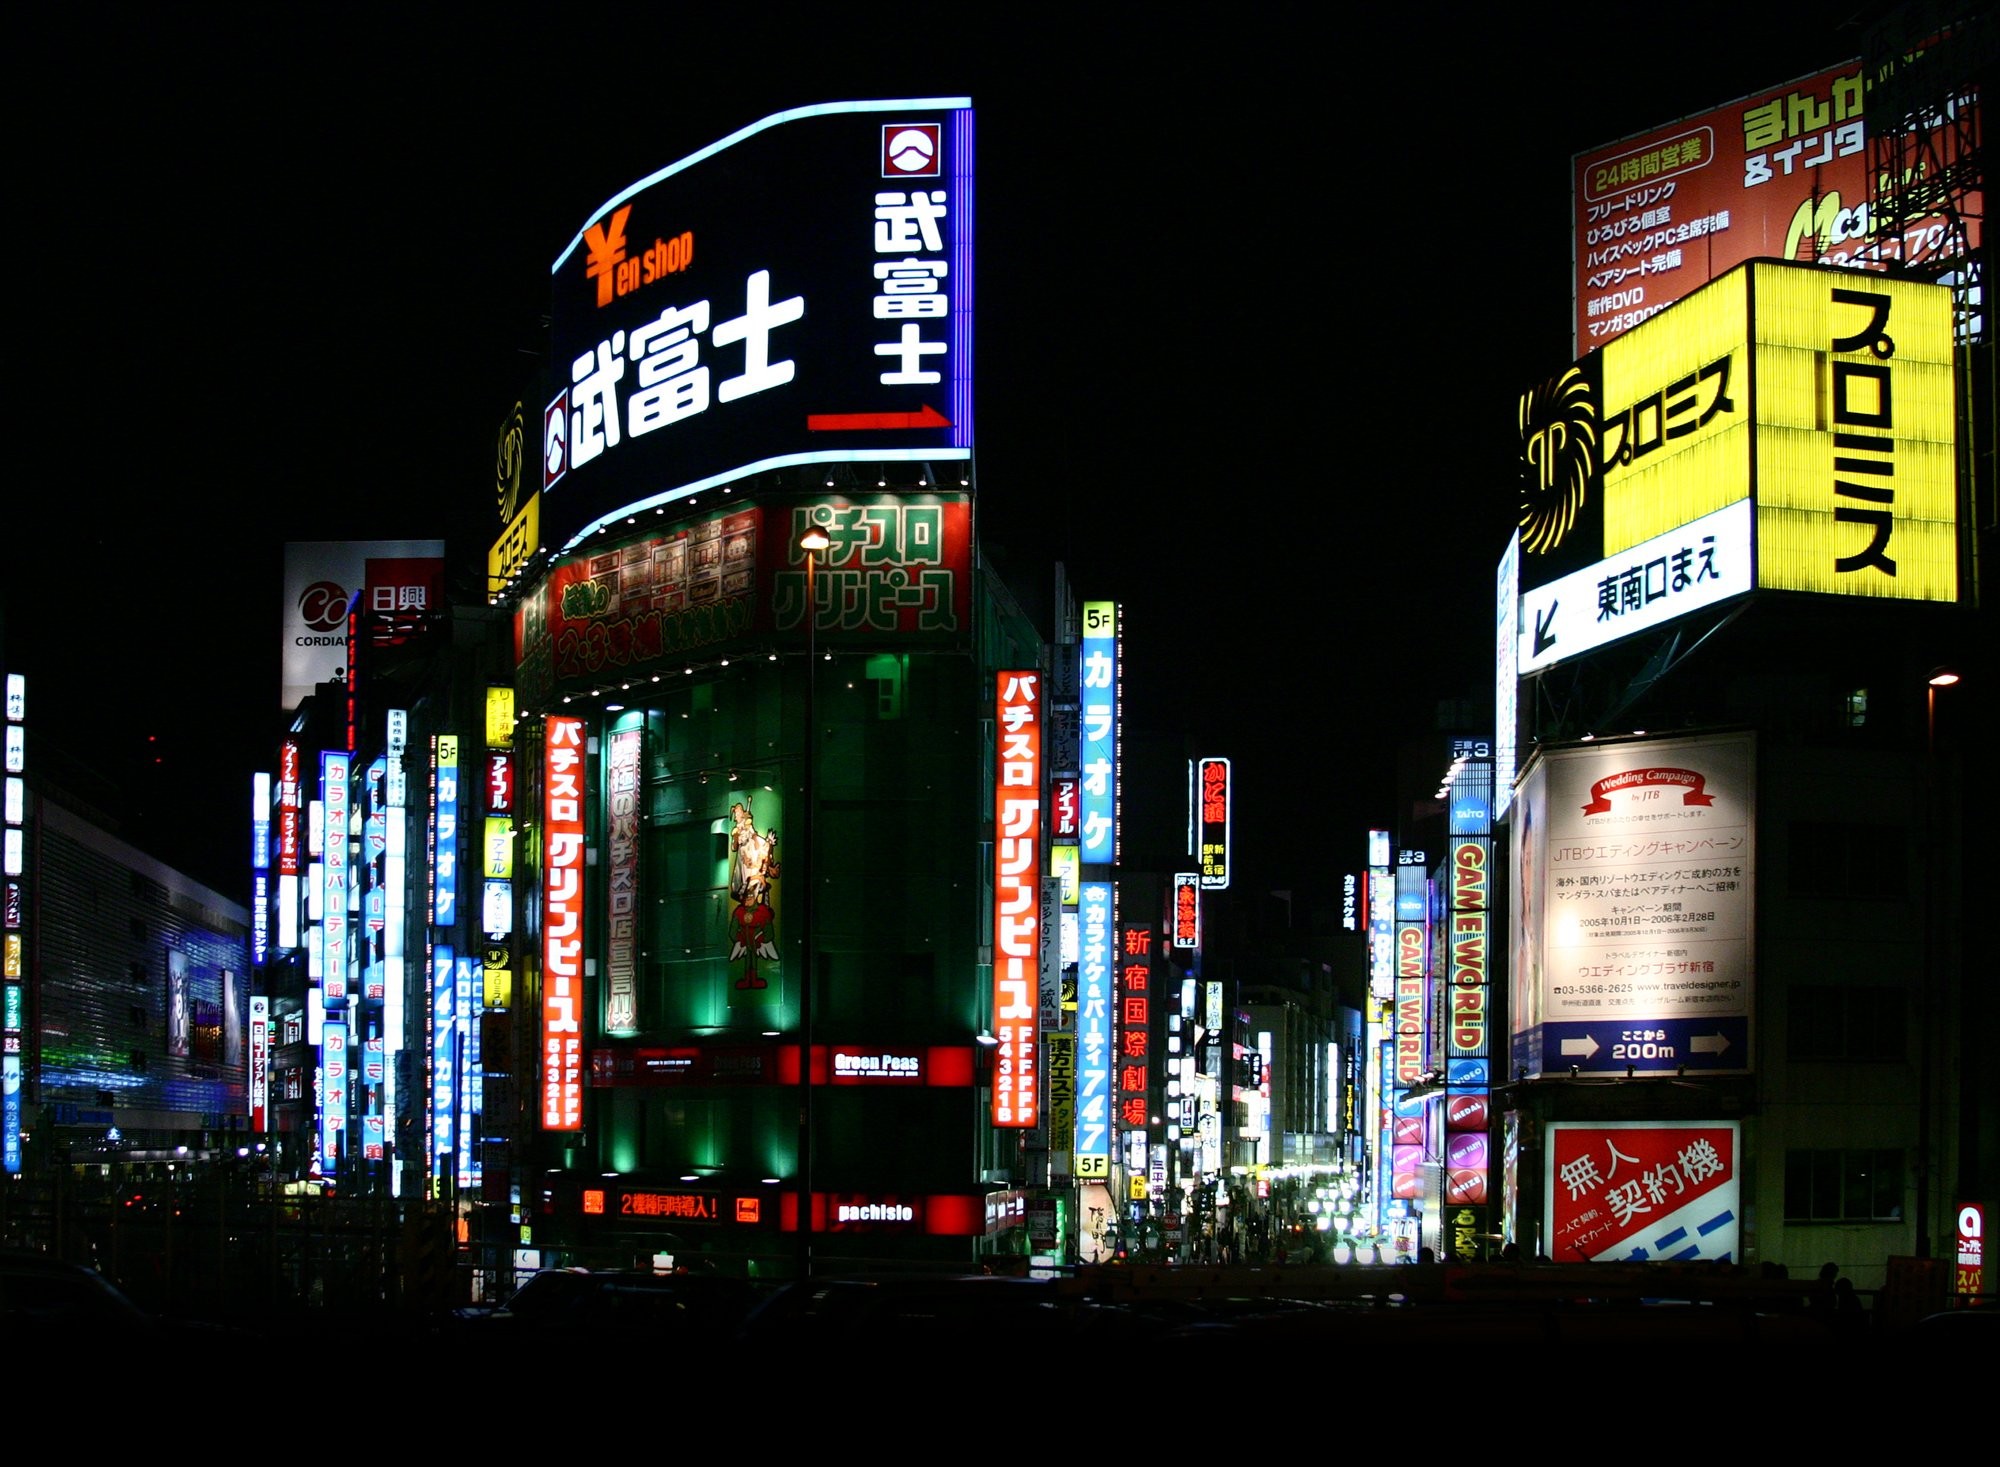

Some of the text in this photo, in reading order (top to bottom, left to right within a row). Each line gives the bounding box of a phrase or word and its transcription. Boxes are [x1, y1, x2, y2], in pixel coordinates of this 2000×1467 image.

[1596, 138, 1701, 191] 24時間営業
[1587, 206, 1671, 245] ひろびろ個室
[1588, 182, 1676, 222] フリードリンク
[643, 231, 693, 284] shop
[1587, 211, 1729, 268] ハイスペックPC全席完備
[873, 190, 948, 385] 武富士
[1587, 249, 1682, 288] ペアシート完備
[1587, 286, 1643, 317] 新作DVD
[571, 269, 804, 469] 武富士
[1603, 354, 1734, 476] プロミス
[1832, 288, 1897, 577] プロミス
[790, 505, 944, 567] パチスロ
[373, 586, 426, 612] 日興
[1597, 535, 1720, 623] 東南口まえ
[1088, 609, 1110, 628] 5F
[440, 743, 456, 759] 5F
[1003, 676, 1036, 786] パチスロ
[1084, 650, 1113, 850] カラオケ
[491, 756, 508, 809] アイフル
[550, 721, 582, 822] パチスロ
[1600, 770, 1696, 790] Wedding Campaign
[1642, 790, 1660, 801] JTB
[1059, 782, 1073, 833] アイフル
[436, 777, 456, 914] カラオケ
[492, 838, 505, 874] アエル
[1553, 836, 1744, 862] JTBウエディングキャンペーン
[1611, 902, 1682, 914] キャンペーン期間
[1454, 938, 1484, 1051] WORLD
[1562, 984, 1633, 995] 03-5366-2625
[1122, 928, 1150, 1126] 新宿国際劇場
[1612, 1042, 1675, 1060] 200m
[1621, 1029, 1666, 1041] ここから
[835, 1053, 918, 1070] Green Peas
[1051, 1038, 1071, 1107] 漢方エステ
[1453, 1102, 1482, 1122] MEDAL
[1082, 1158, 1104, 1171] 5F
[1452, 1174, 1481, 1194] PRIZE
[1560, 1138, 1640, 1201] 無人
[1604, 1138, 1724, 1228] 契約機
